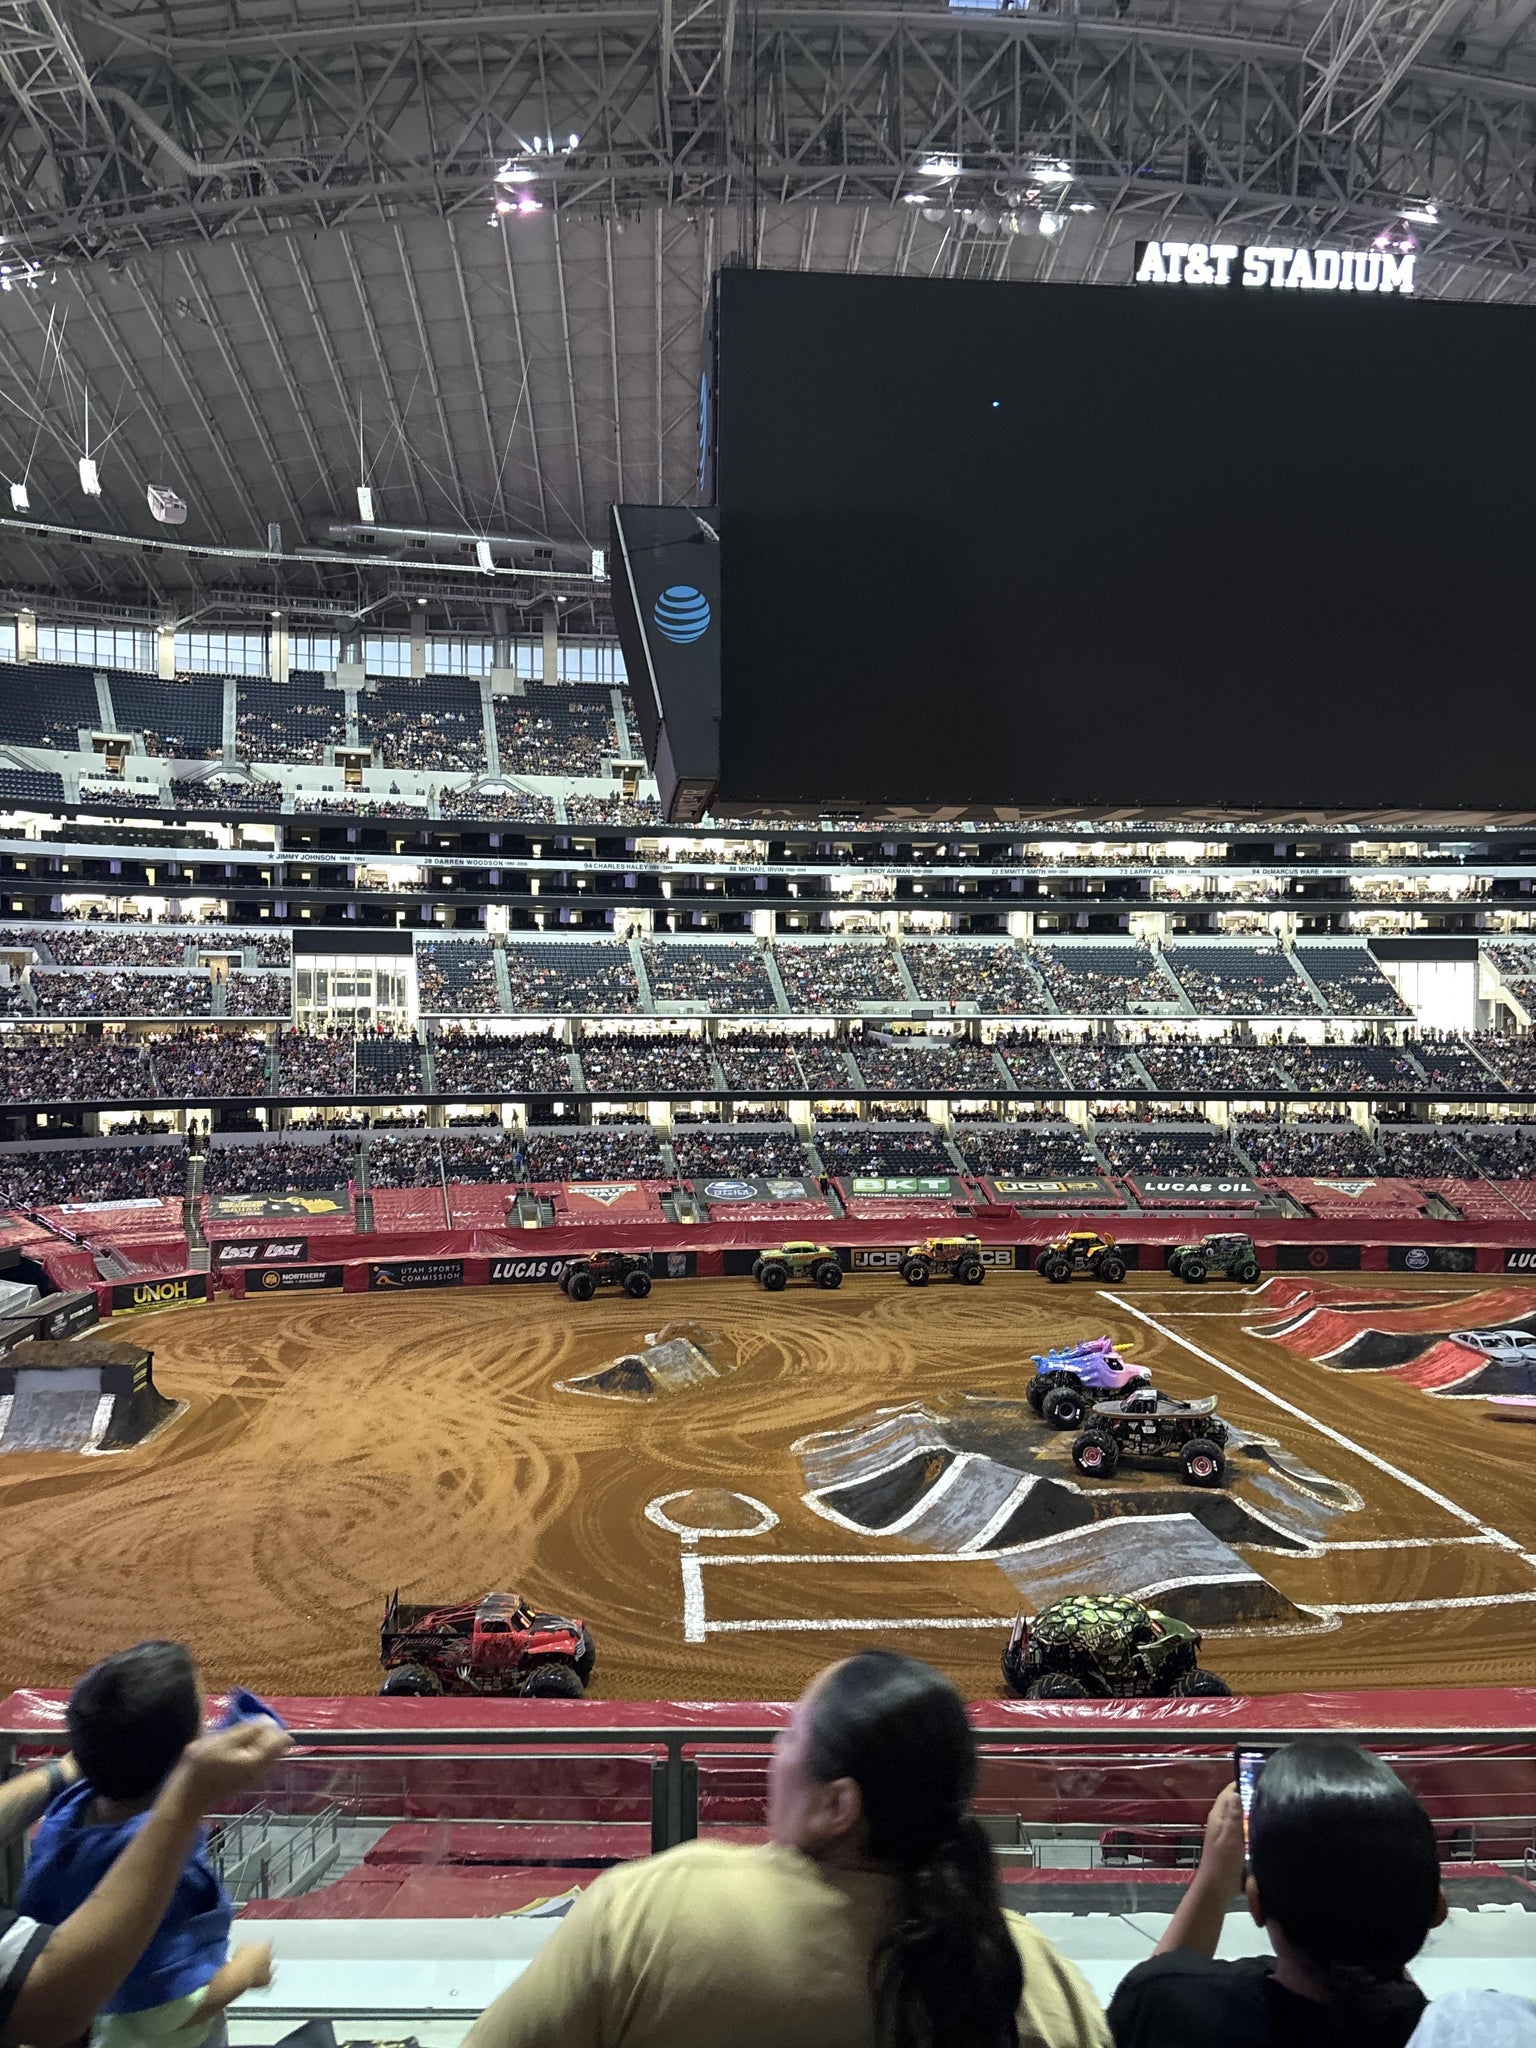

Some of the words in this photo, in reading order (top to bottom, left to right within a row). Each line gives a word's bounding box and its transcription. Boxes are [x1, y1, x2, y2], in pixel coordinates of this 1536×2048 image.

[1136, 241, 1239, 285] AT&T
[1242, 246, 1415, 292] STADIUM
[855, 1179, 946, 1190] BKT
[1003, 1182, 1060, 1191] JCB
[1144, 1182, 1212, 1192] LUCAS
[1218, 1183, 1252, 1192] OIL
[855, 1252, 900, 1266] JCB
[980, 1251, 1011, 1264] CB
[401, 1266, 425, 1274] UTAH
[428, 1264, 461, 1273] SPORTS
[492, 1261, 549, 1279] LUCAS
[282, 1272, 326, 1280] NORTHERN
[401, 1272, 460, 1283] COMMISSION
[133, 1280, 188, 1304] UNOH
